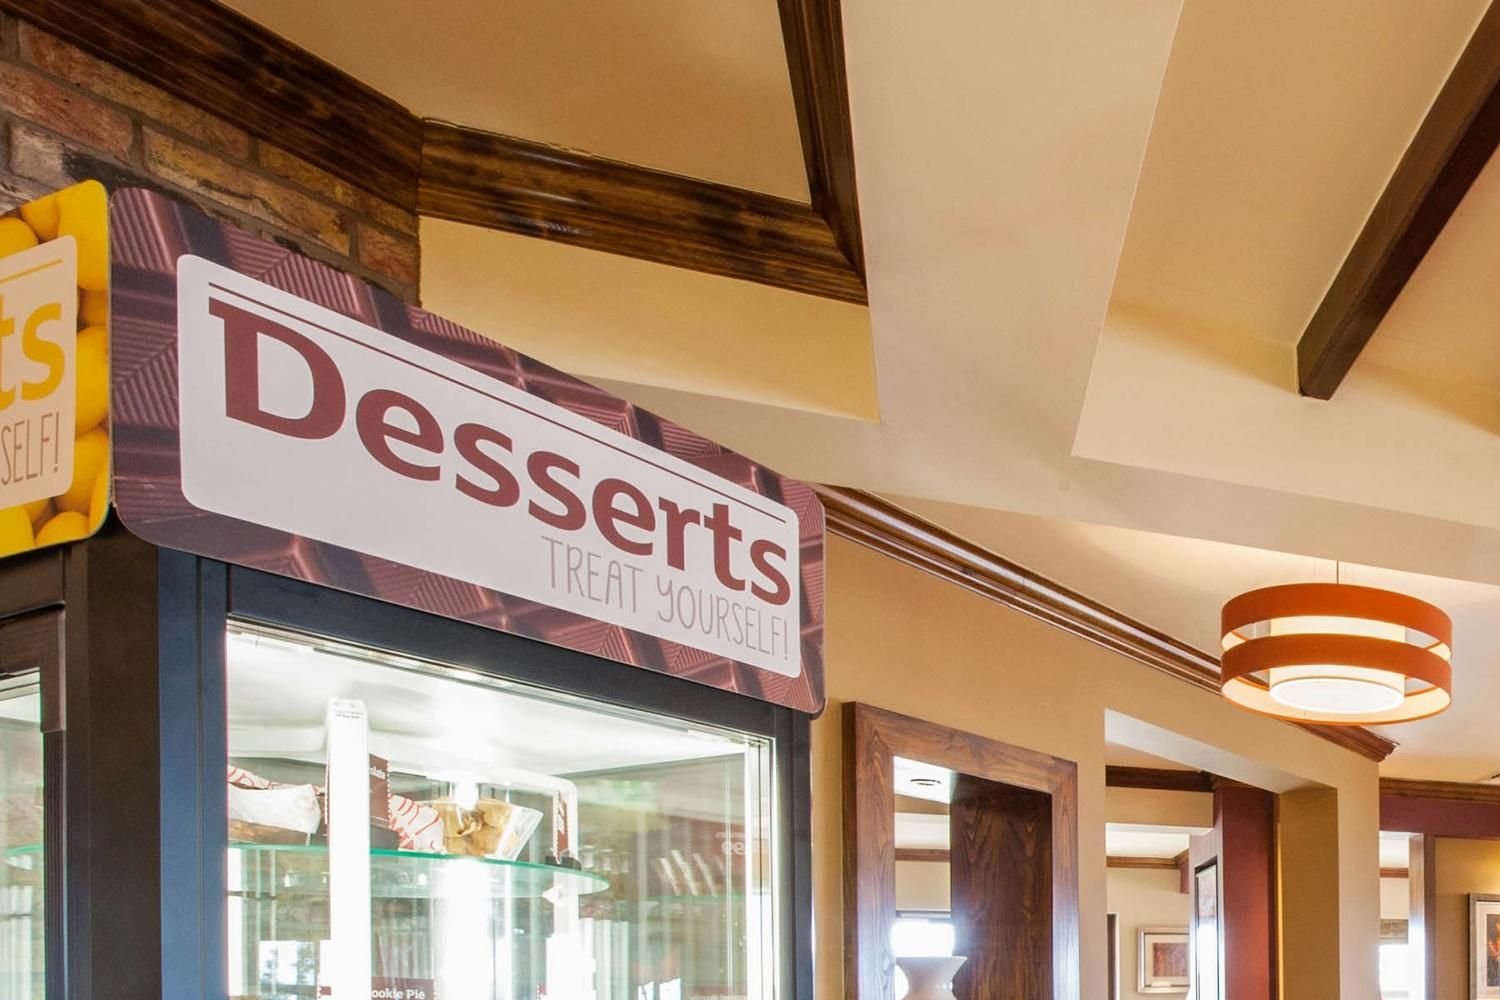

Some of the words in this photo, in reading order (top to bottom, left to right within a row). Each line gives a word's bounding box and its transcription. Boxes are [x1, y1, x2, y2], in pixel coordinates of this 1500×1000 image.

[208, 296, 792, 605] Desserts
[541, 535, 644, 614] TREAT
[656, 574, 789, 661] YOURSELF!
[406, 988, 426, 1000] Pie
